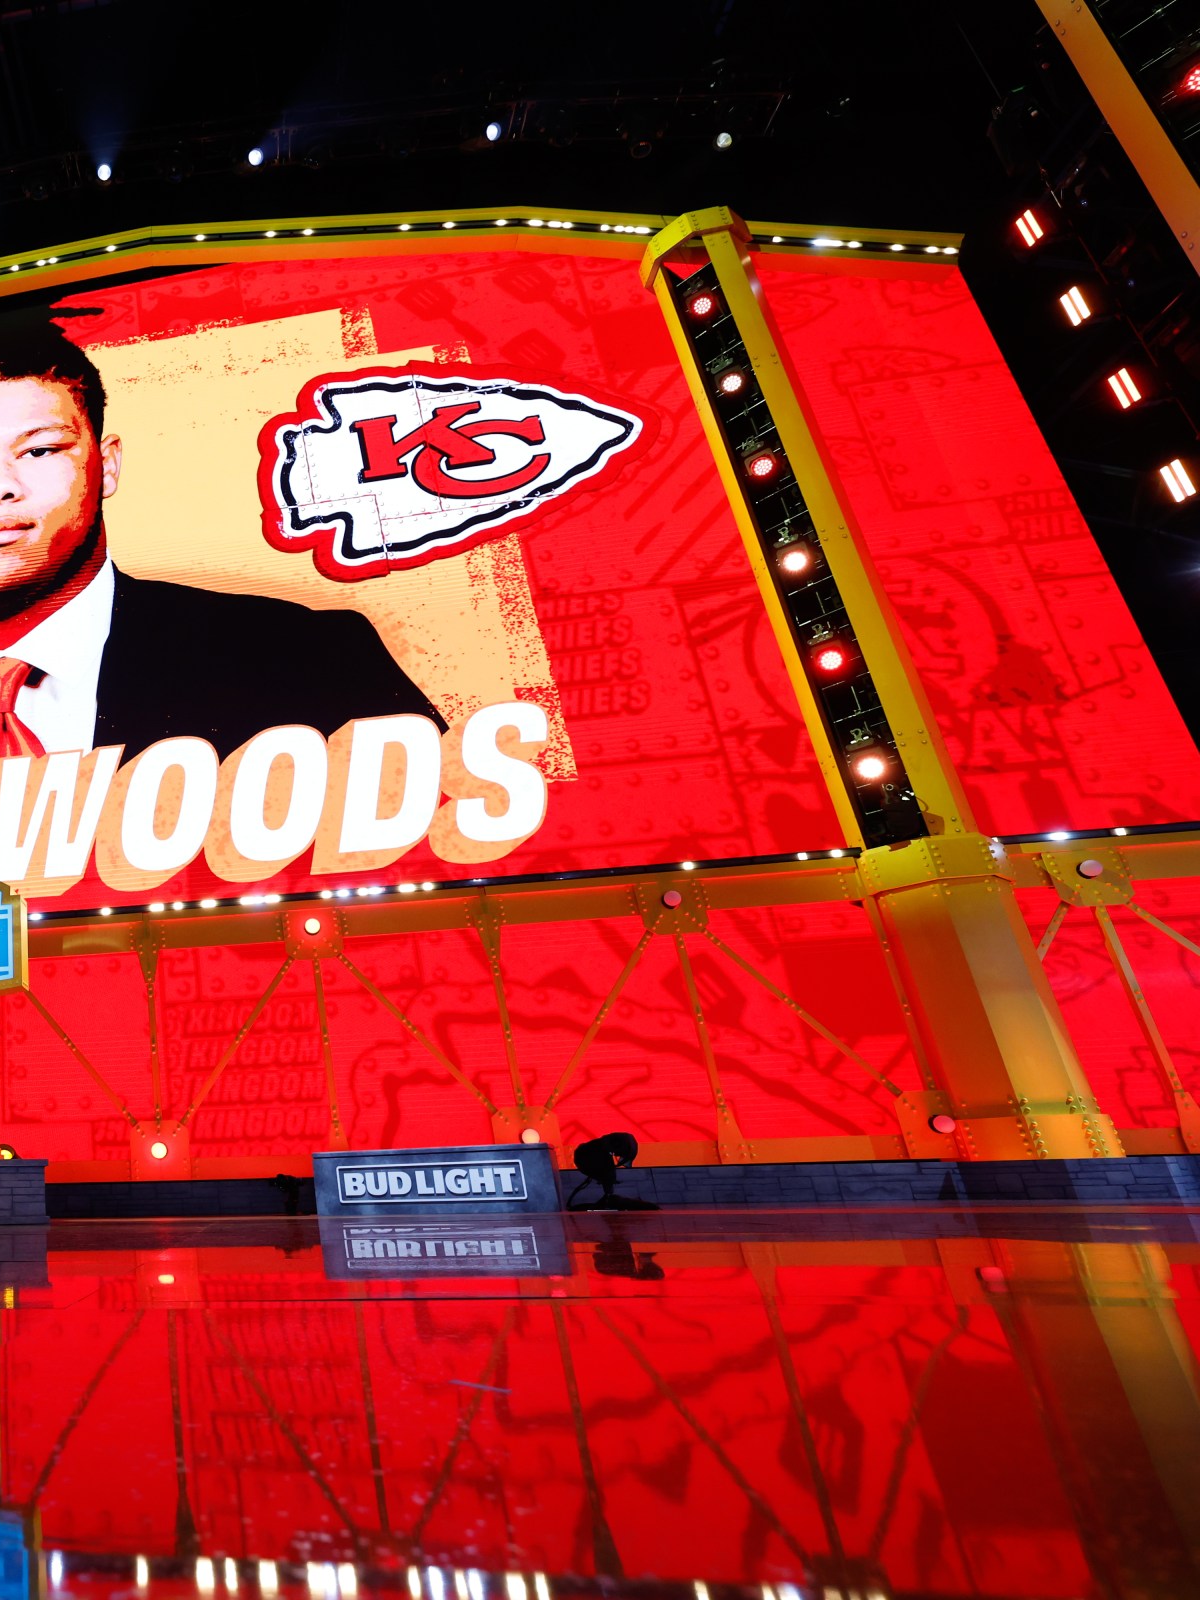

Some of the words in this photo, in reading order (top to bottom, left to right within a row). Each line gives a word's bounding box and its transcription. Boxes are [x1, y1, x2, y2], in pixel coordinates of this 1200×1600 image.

[350, 401, 551, 499] KC
[195, 1108, 328, 1140] KINGDOM
[344, 1171, 412, 1197] BUD
[415, 1168, 516, 1195] LIGHT
